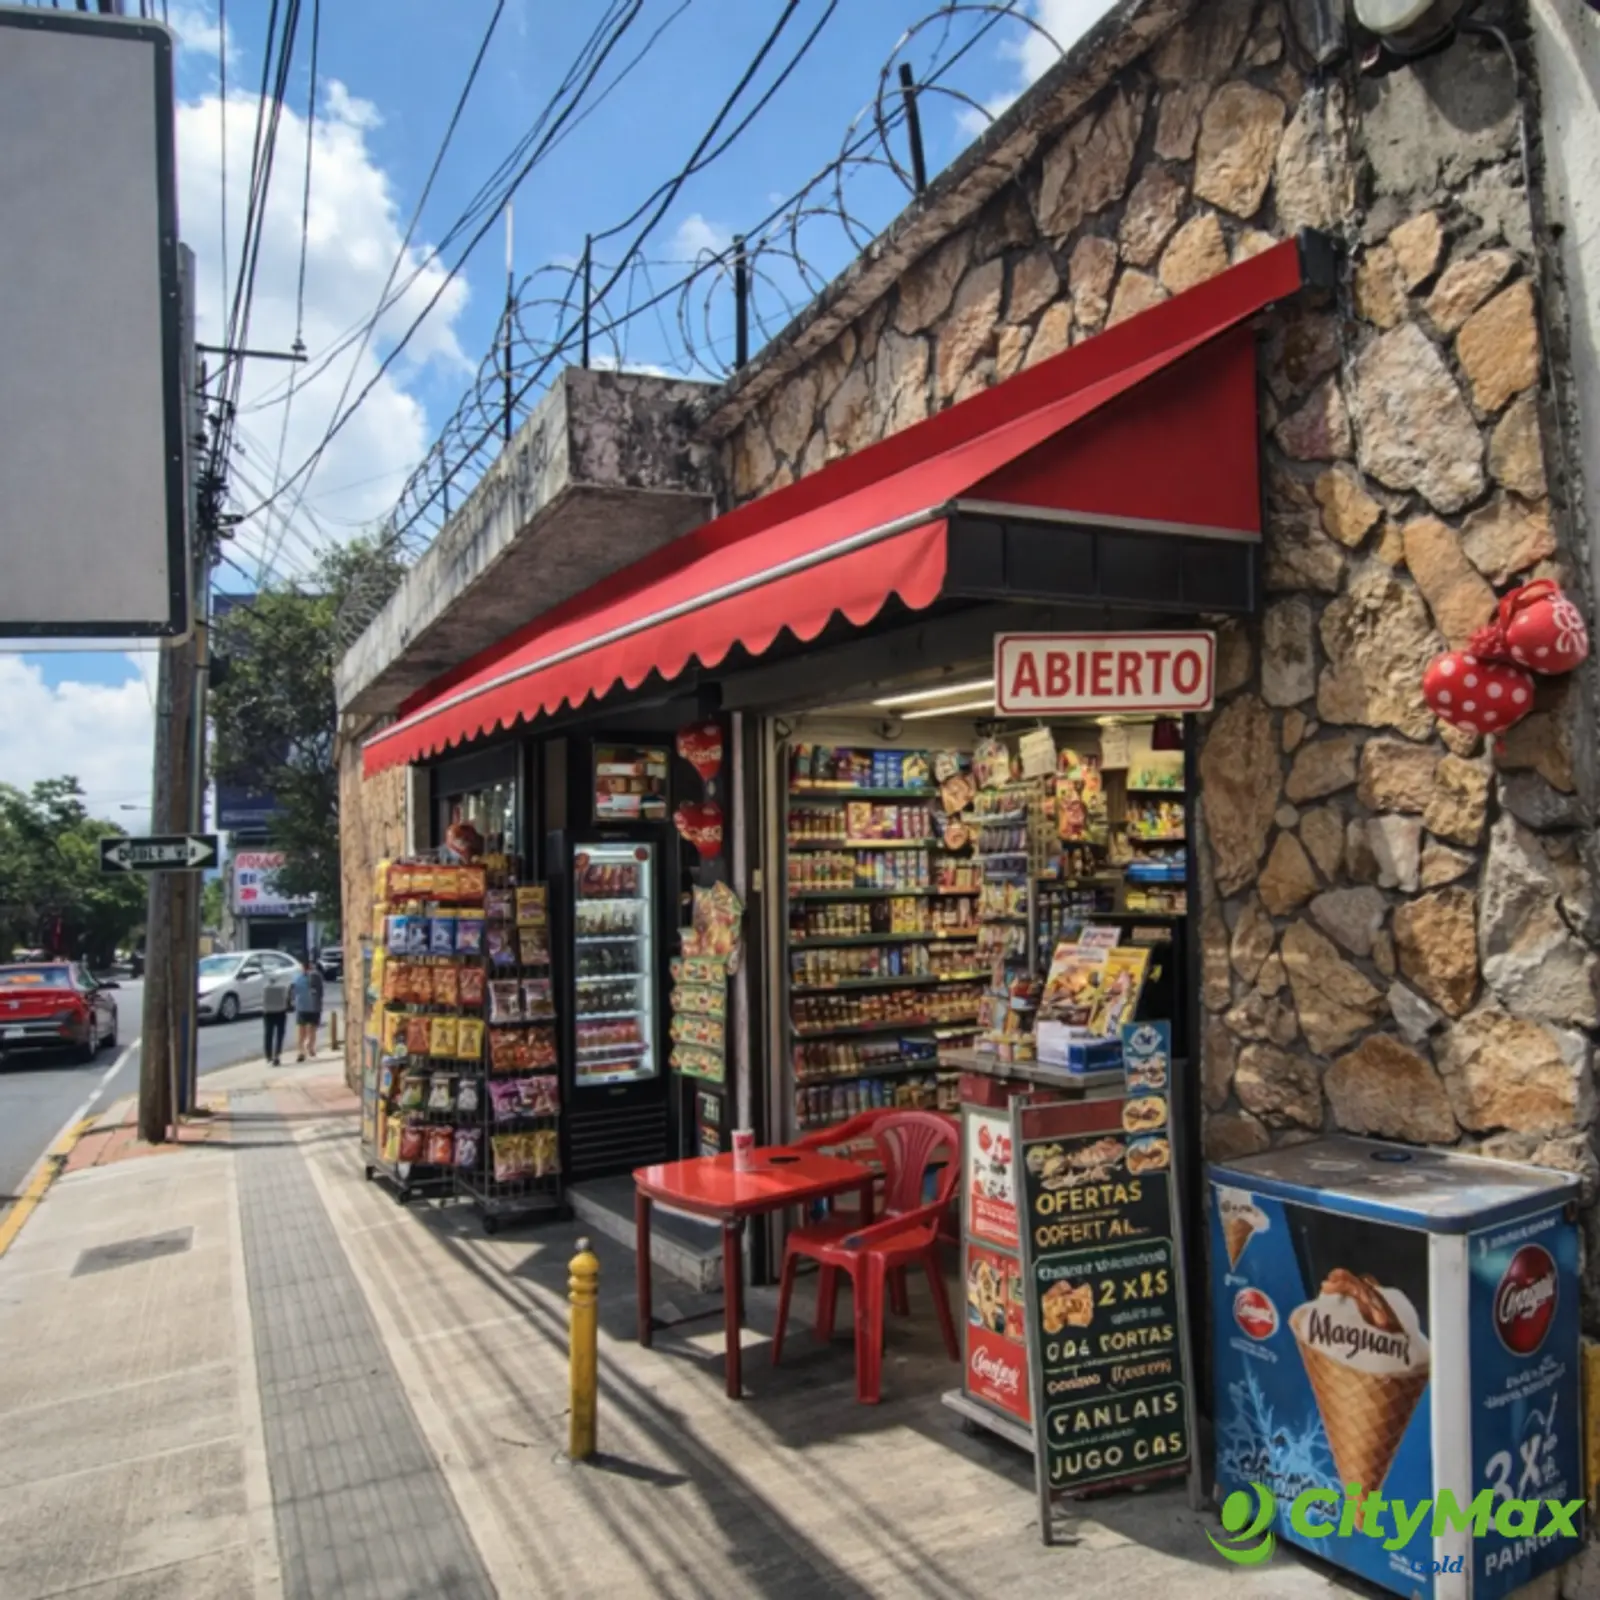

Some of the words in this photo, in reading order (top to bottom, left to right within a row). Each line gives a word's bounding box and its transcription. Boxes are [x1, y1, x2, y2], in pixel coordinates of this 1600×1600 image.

[1010, 649, 1203, 698] ABIERTO
[1034, 1180, 1143, 1216] OFERTAS
[1050, 1445, 1124, 1480] JUGO
